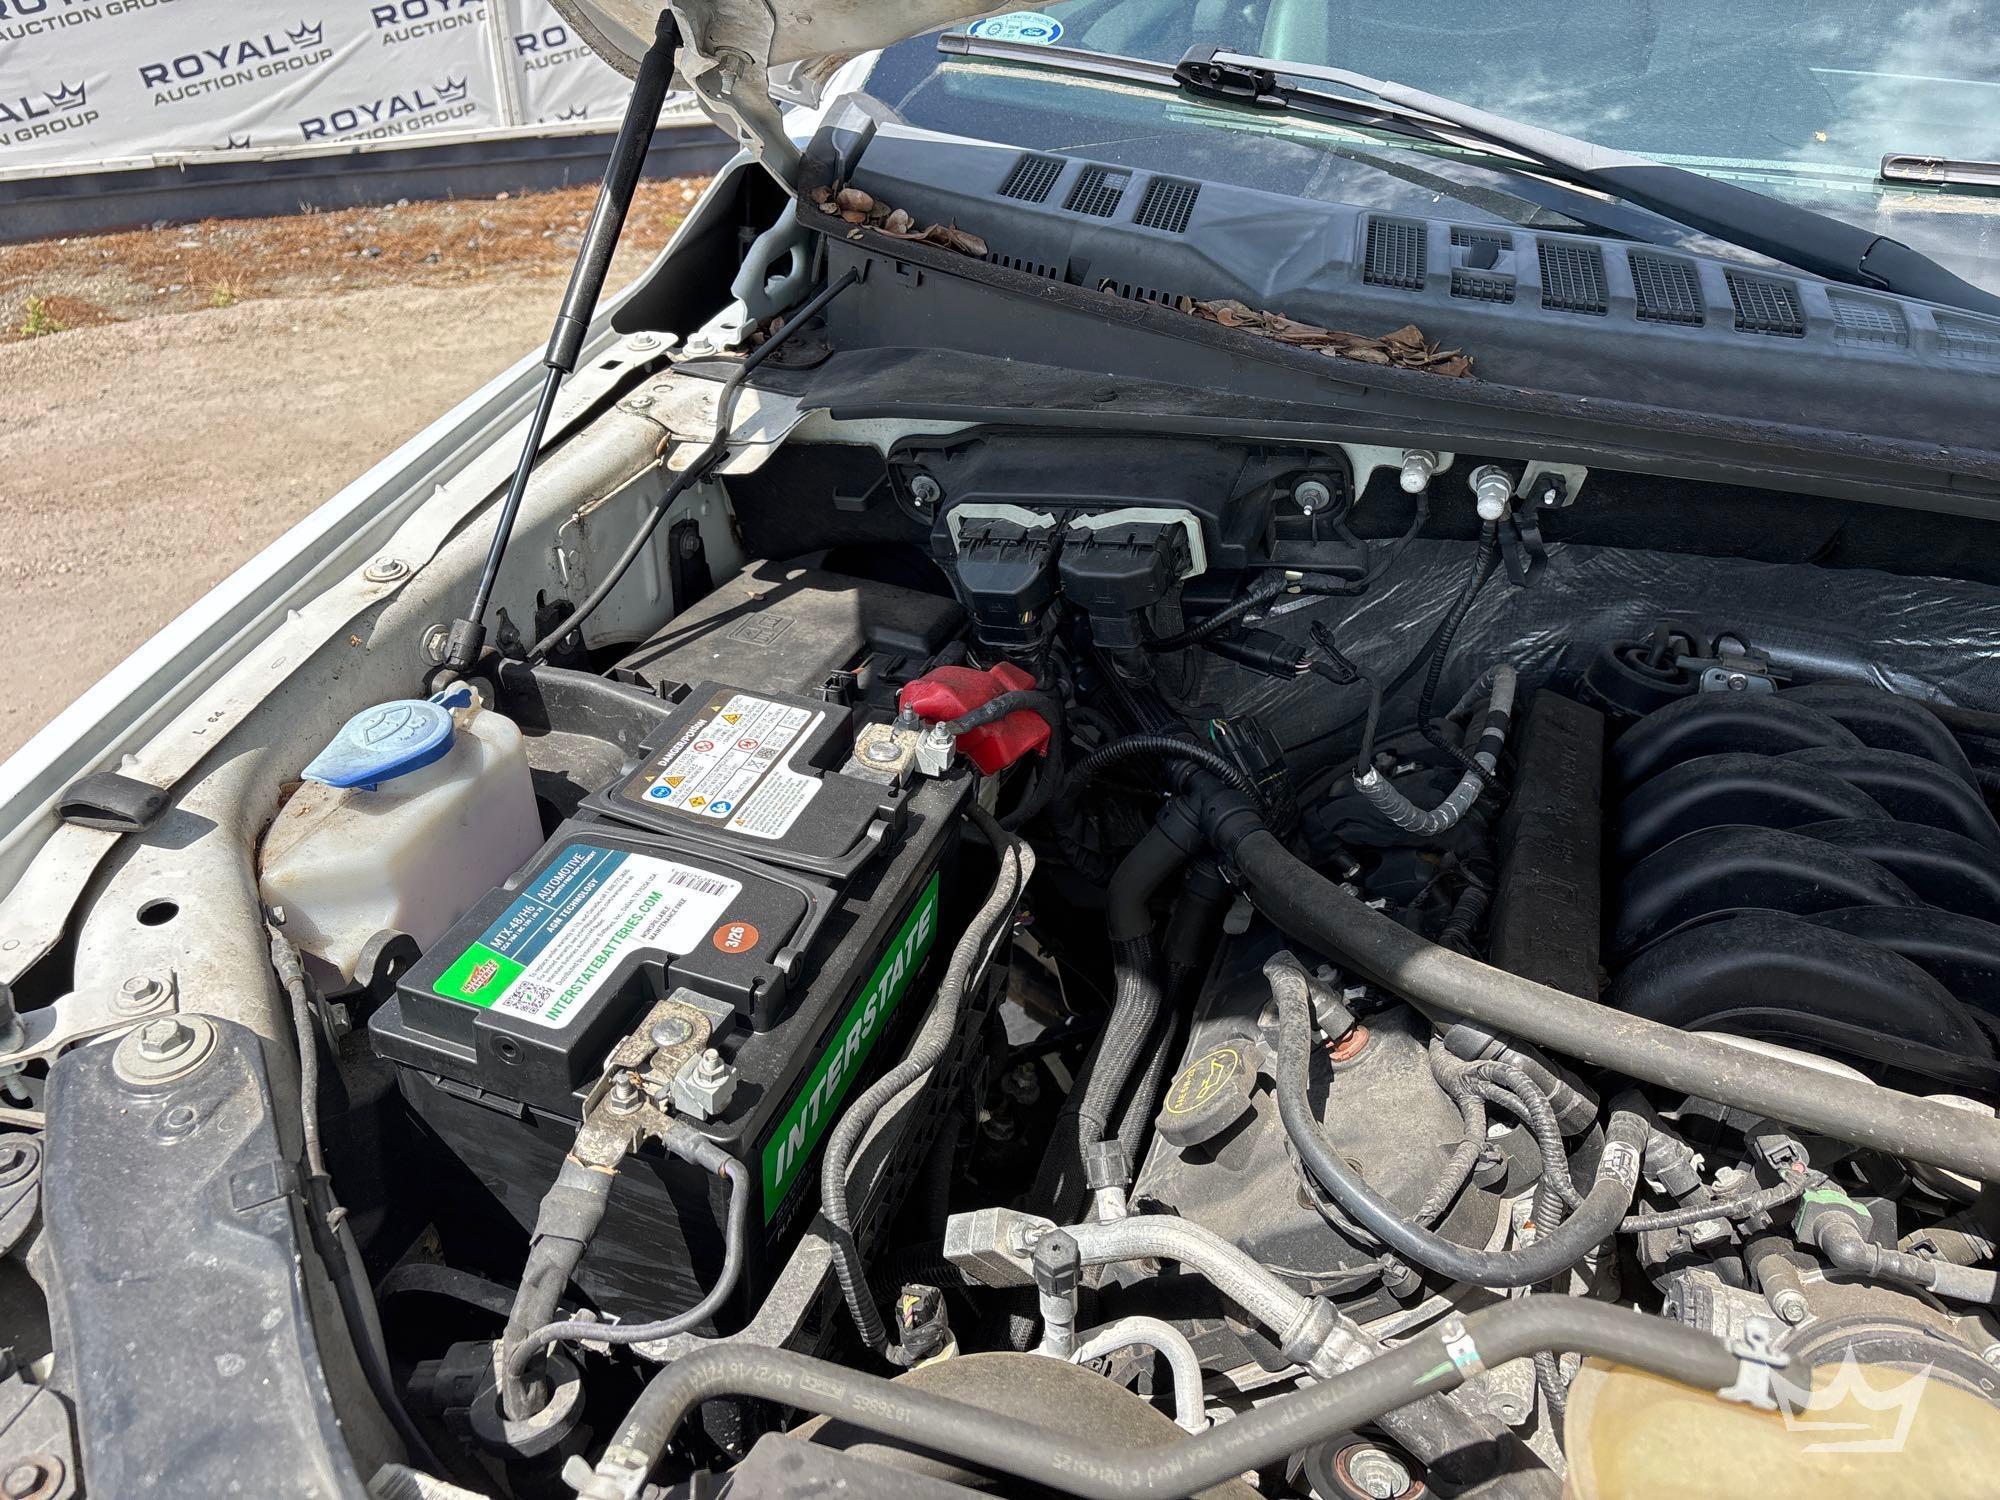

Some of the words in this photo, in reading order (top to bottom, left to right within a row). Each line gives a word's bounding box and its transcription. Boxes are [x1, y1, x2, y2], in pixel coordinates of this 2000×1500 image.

[382, 12, 472, 46] AUCTION
[139, 34, 289, 89] ROYAL
[154, 69, 253, 107] AUCTION
[257, 48, 334, 78] GROUP
[14, 110, 99, 142] GROUP
[300, 90, 437, 141] ROYAL
[406, 102, 477, 132] GROUP
[656, 718, 708, 767] DANGER/POISON
[535, 852, 585, 900] AUTOMOTIVE
[489, 904, 535, 948] MTX-48/H6
[545, 917, 563, 933] AGM
[559, 877, 599, 917] TECHNOLOGY
[543, 890, 664, 1021] INTERSTATEBATTERIES.COM
[724, 926, 745, 948] 3/26
[774, 897, 932, 1189] INTERSTATE
